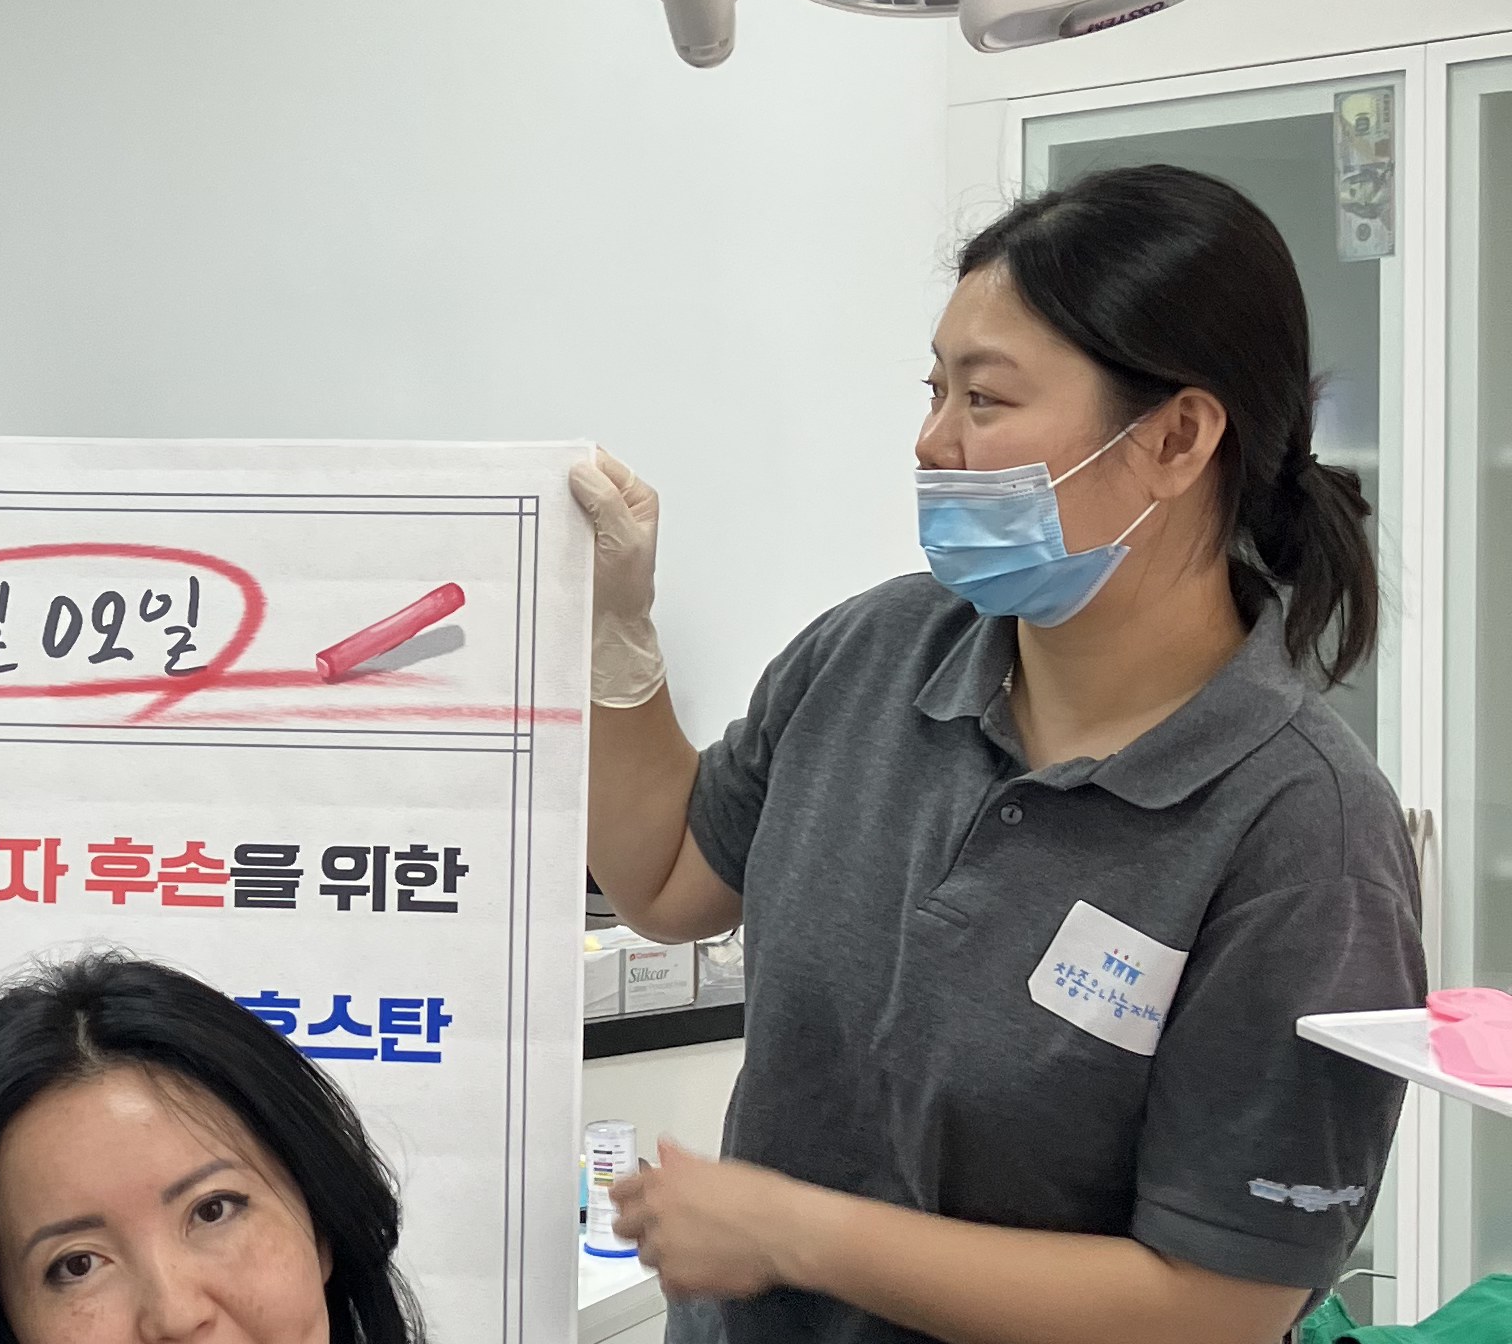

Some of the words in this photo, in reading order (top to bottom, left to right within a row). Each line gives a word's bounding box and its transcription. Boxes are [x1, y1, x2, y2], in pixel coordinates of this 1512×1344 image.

[41, 575, 209, 677] 02일
[84, 836, 305, 910] 후손을
[318, 843, 470, 914] 위한
